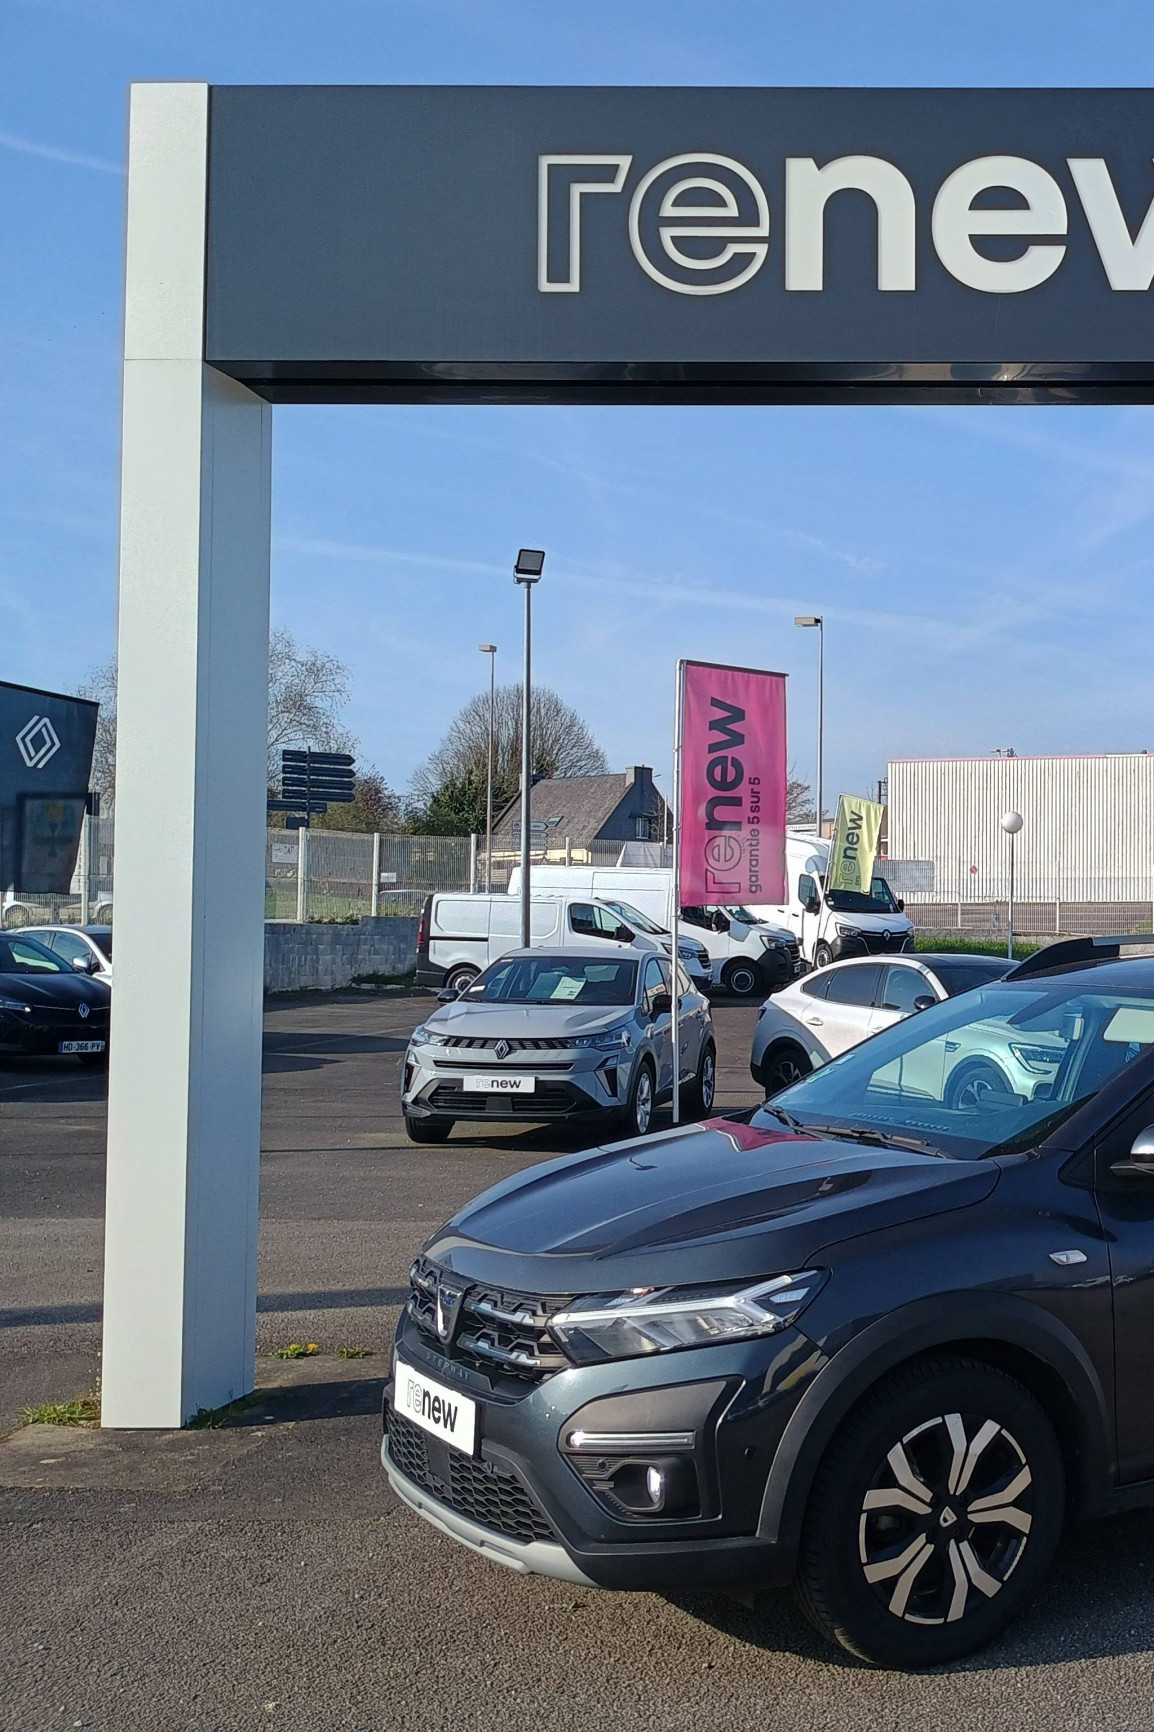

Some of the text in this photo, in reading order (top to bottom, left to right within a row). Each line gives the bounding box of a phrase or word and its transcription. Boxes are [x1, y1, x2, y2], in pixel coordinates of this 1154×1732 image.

[704, 696, 746, 894] renew
[748, 776, 762, 894] garantie 5 sur 5
[838, 810, 864, 885] renew
[475, 1079, 522, 1089] renew
[425, 1352, 471, 1380] STEPWAY
[406, 1378, 459, 1433] renew
